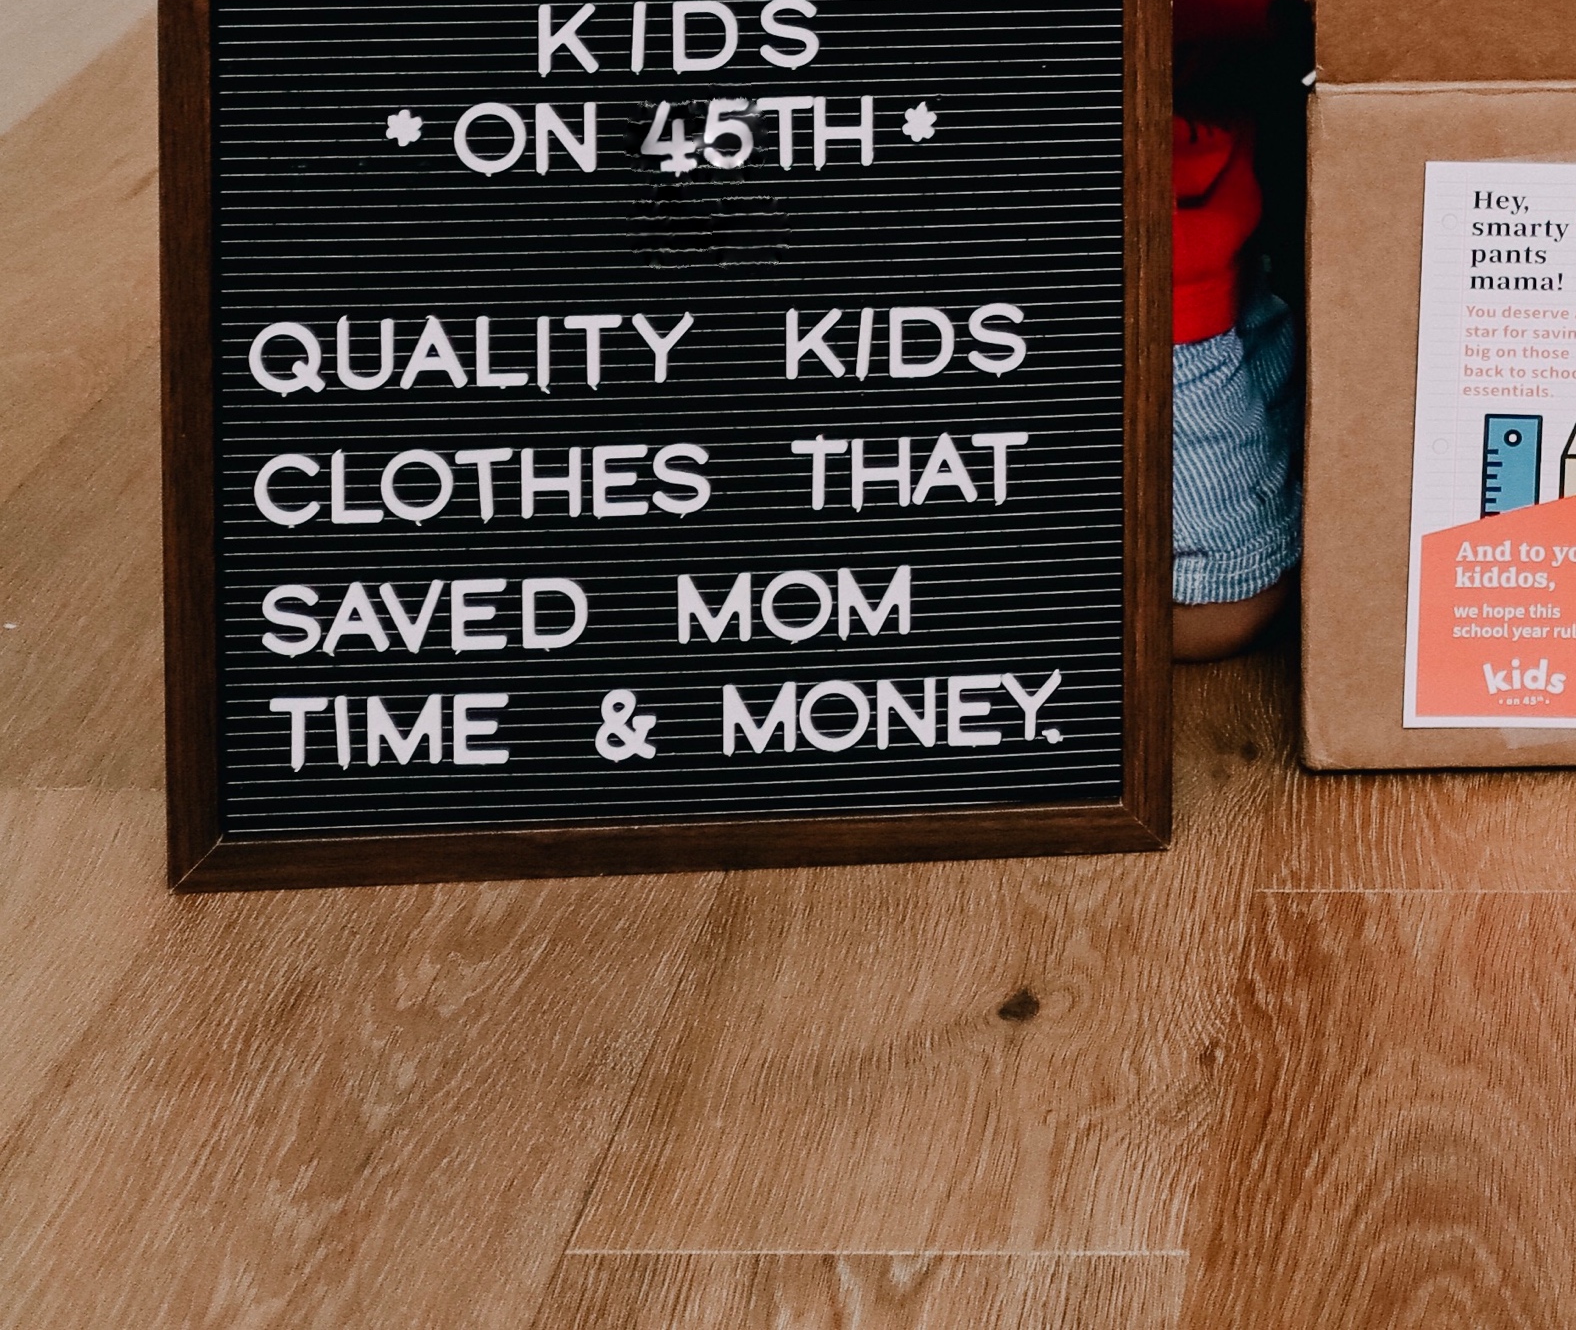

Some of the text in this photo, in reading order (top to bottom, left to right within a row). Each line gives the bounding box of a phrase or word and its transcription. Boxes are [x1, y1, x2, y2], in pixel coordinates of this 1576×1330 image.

[453, 95, 874, 177] ON 45TH
[1473, 190, 1530, 215] Hey,
[1471, 219, 1570, 242] smarty
[1471, 245, 1547, 267] pants
[1470, 272, 1564, 291] mama!
[1466, 305, 1496, 319] You
[1501, 305, 1570, 320] deserve
[1465, 326, 1498, 338] star
[1503, 325, 1527, 338] for
[248, 303, 1028, 396] QUALITY KIDS
[1465, 344, 1570, 362] big on those
[1463, 364, 1504, 378] back
[1509, 366, 1526, 378] to
[1462, 384, 1554, 398] essentials.
[253, 431, 1029, 528] CLOTHES THAT
[1455, 540, 1512, 562] And
[1519, 543, 1545, 562] to
[1455, 567, 1556, 591] kiddos,
[260, 565, 911, 657] SAVED MOM
[1453, 603, 1561, 621] we hope this
[1452, 623, 1508, 638] school
[1512, 626, 1550, 641] year
[1482, 658, 1566, 694] kids
[269, 668, 1063, 772] TIME & MONEY.
